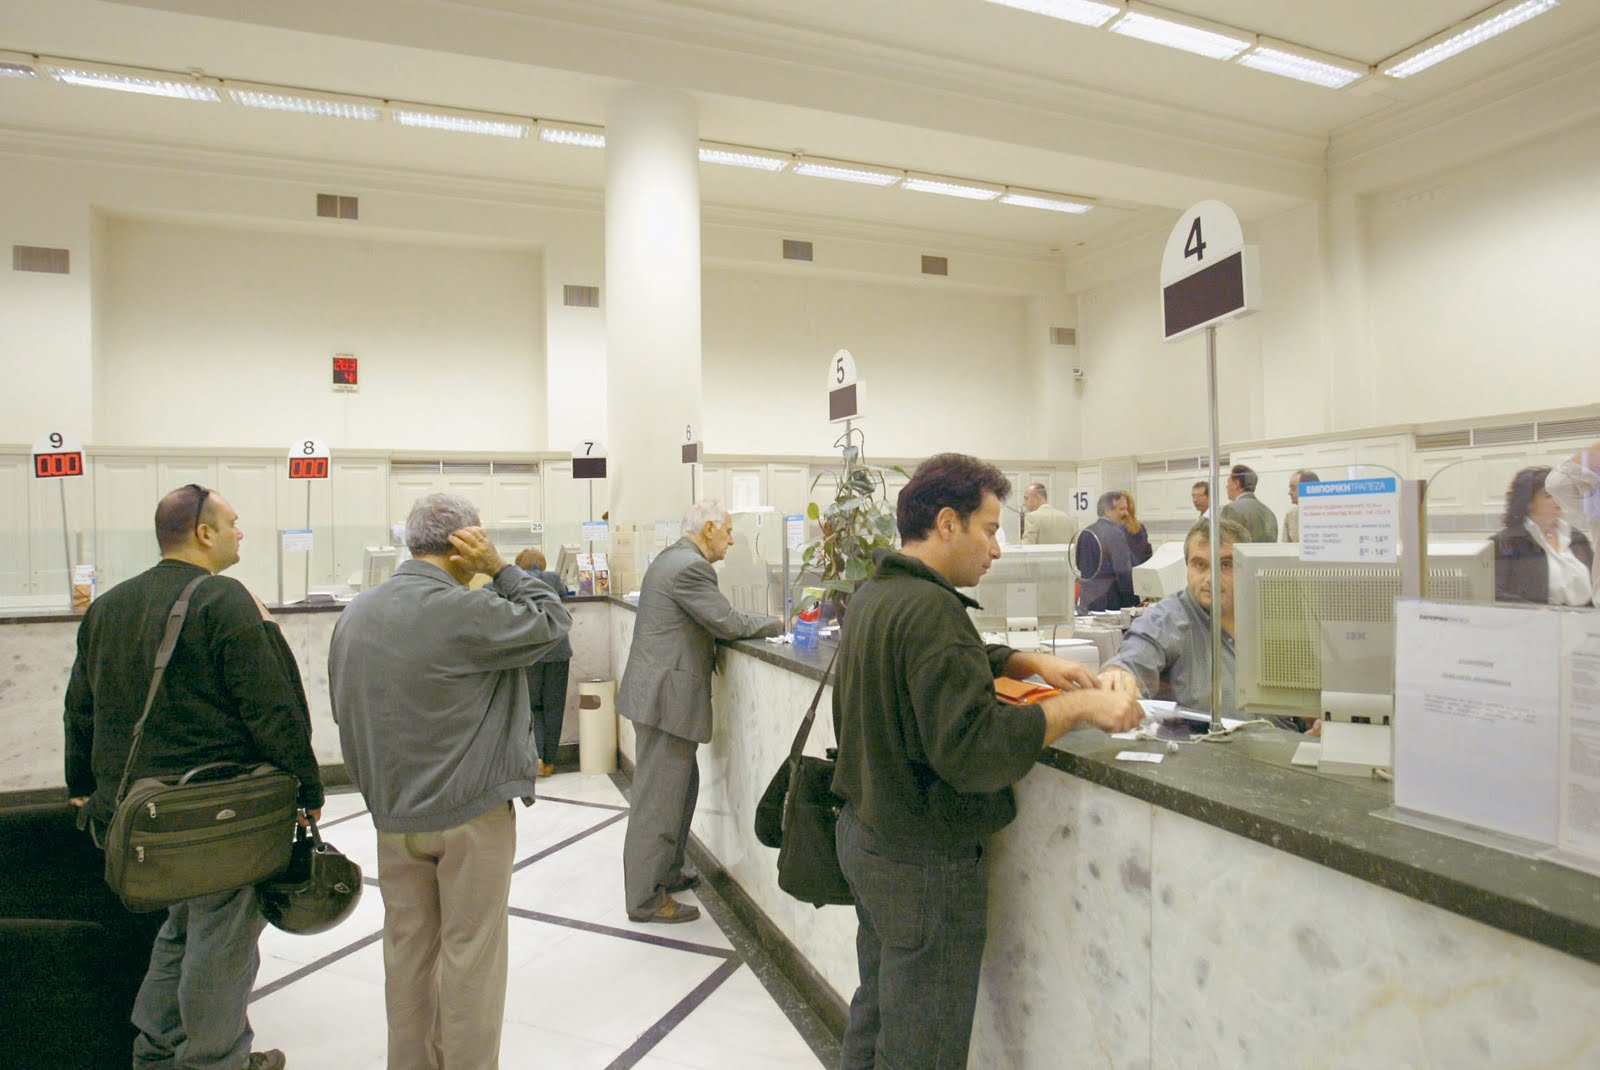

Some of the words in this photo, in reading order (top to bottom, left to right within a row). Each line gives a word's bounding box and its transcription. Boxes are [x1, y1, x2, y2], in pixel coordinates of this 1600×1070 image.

[1184, 216, 1207, 261] 4
[837, 357, 845, 384] 5
[50, 432, 63, 449] 9
[686, 424, 691, 441] 6
[303, 440, 315, 455] 8
[584, 442, 594, 456] 7
[37, 453, 81, 476] 000
[290, 459, 327, 478] 000
[1073, 491, 1089, 511] 15
[532, 523, 543, 531] 25
[1345, 631, 1366, 640] IBM
